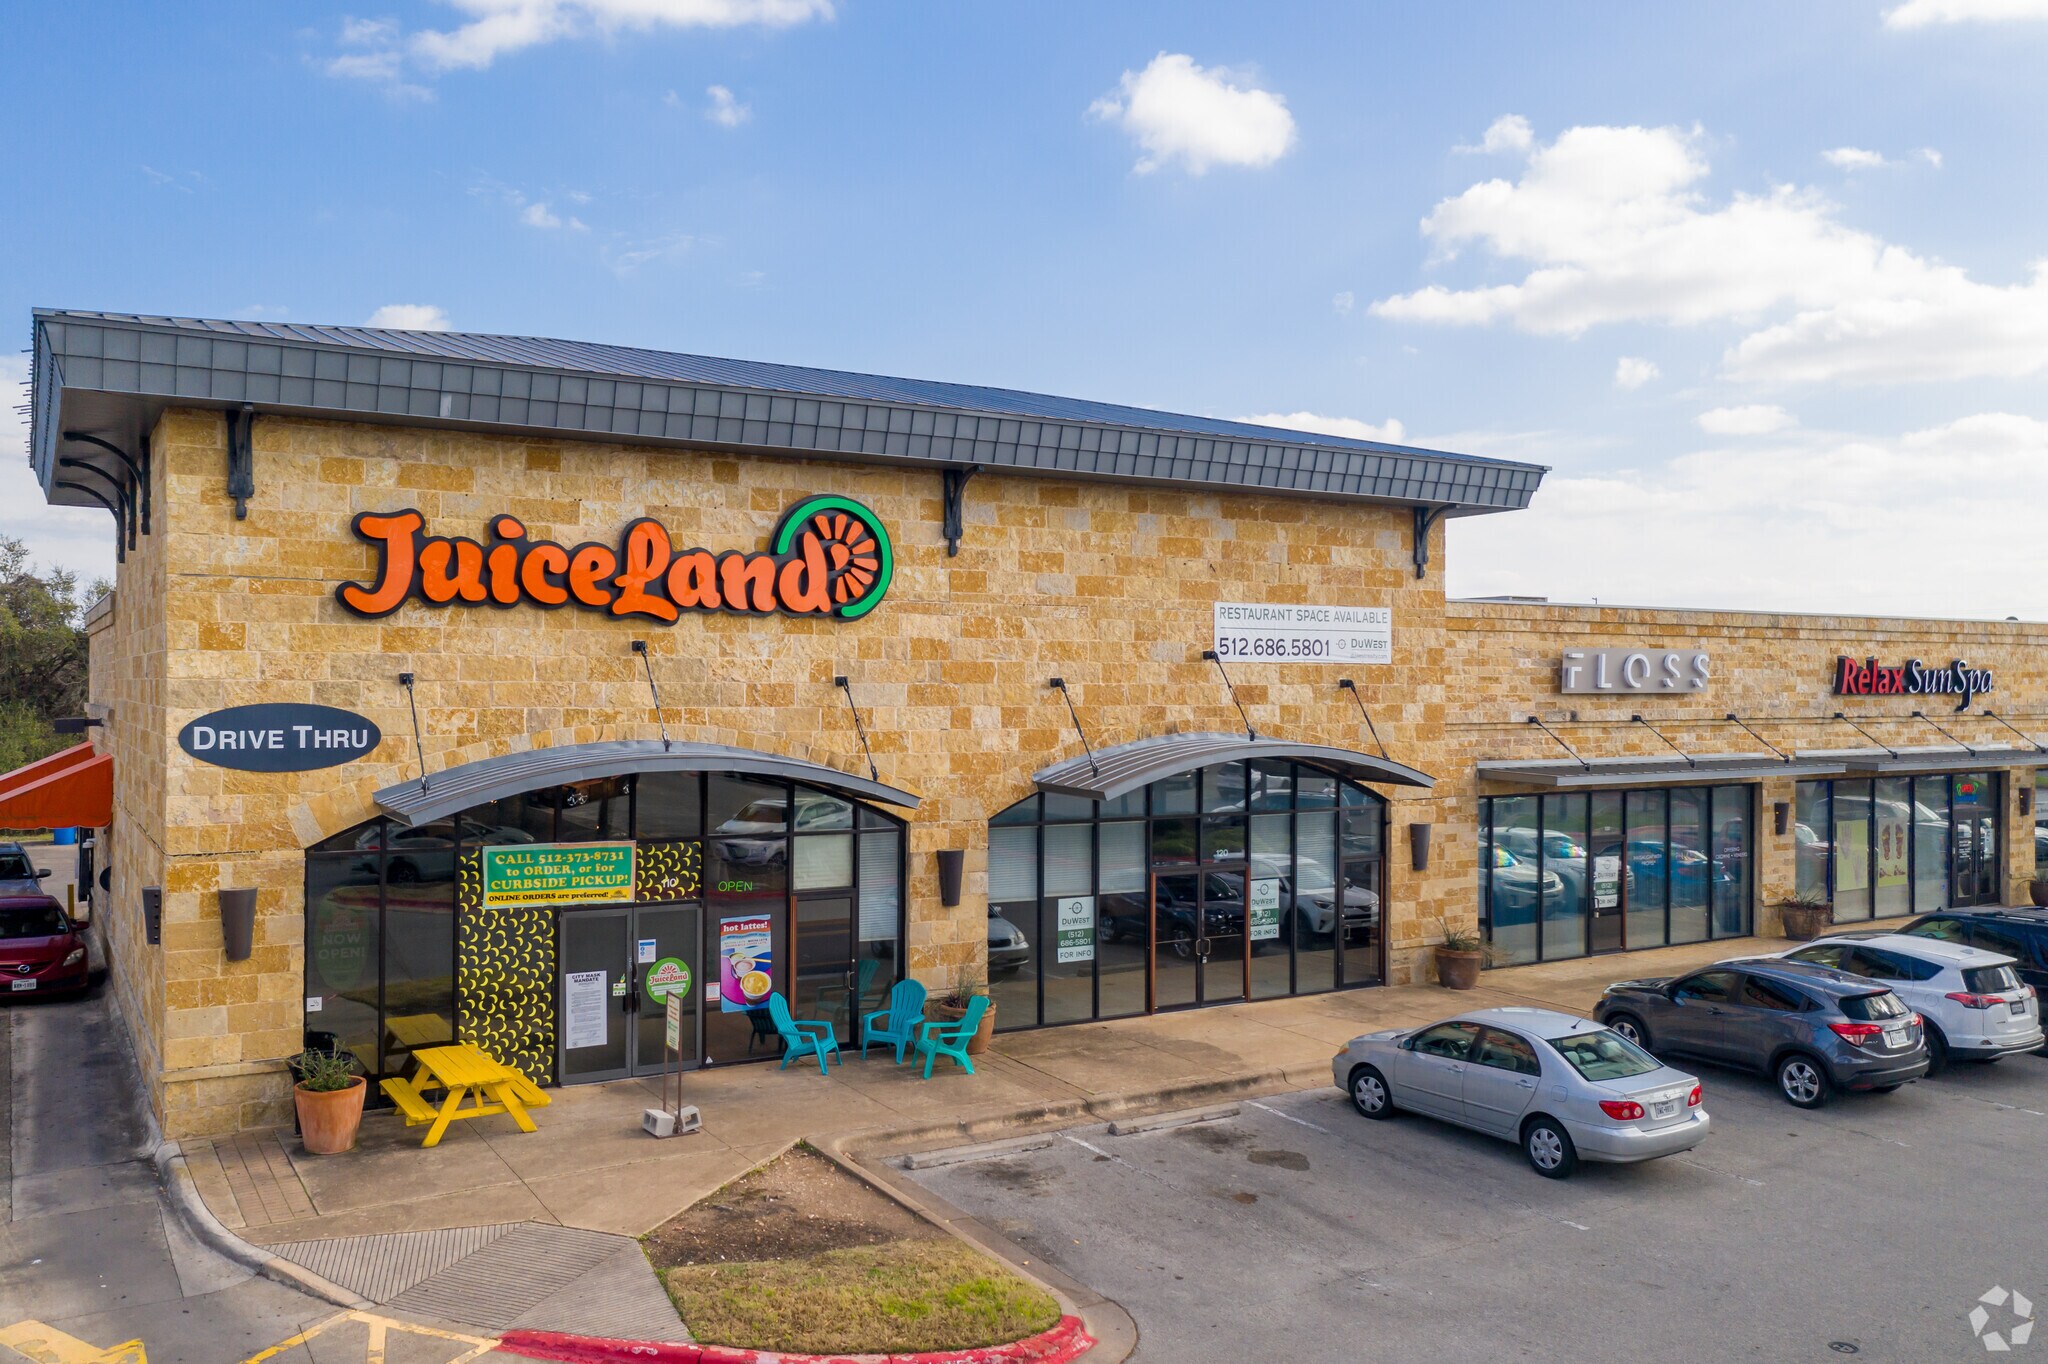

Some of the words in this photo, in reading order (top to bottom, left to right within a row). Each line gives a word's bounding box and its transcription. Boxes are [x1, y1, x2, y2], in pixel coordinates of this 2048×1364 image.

[336, 508, 834, 626] JuiceLand
[1219, 606, 1292, 622] RESTAURANT
[1296, 609, 1330, 623] SPACE
[1333, 611, 1388, 625] AVAILABLE
[1219, 637, 1330, 657] 512.686.5801
[1567, 652, 1710, 688] FLOSS
[1840, 657, 1905, 695] Relax
[495, 853, 535, 865] CALL
[538, 851, 625, 864] 512-373-8731
[1215, 848, 1229, 857] 120
[506, 868, 520, 877] to
[523, 864, 575, 876] ORDER,
[578, 865, 592, 873] or
[595, 863, 615, 872] for
[490, 877, 567, 890] CURBSIDE
[717, 881, 753, 892] OPEN
[522, 893, 556, 901] ORDERS
[571, 891, 609, 900] preferred!
[723, 924, 739, 932] hot
[740, 921, 768, 931] lattes!
[1067, 930, 1084, 938] (512)
[1075, 949, 1092, 957] INFO
[650, 972, 688, 984] JuiceLand
